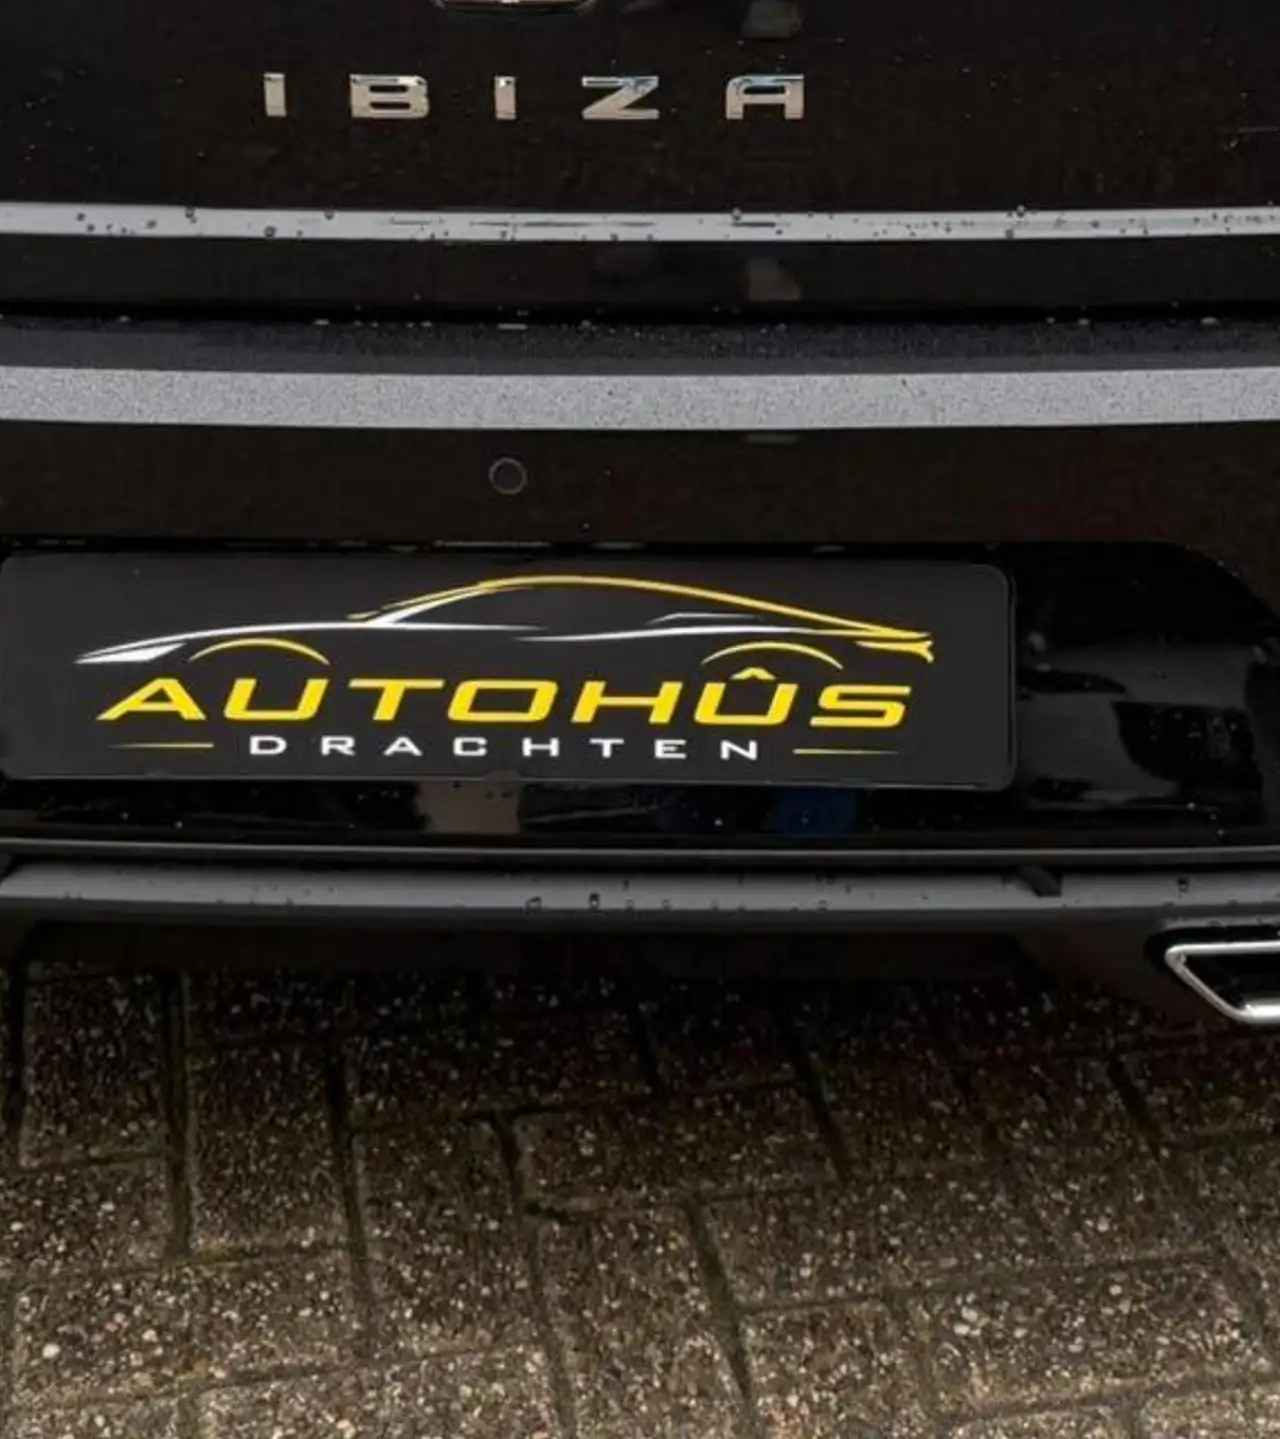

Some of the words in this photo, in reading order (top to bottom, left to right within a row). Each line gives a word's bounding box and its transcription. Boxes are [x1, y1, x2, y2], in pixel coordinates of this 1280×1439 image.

[263, 72, 805, 120] IBIZA
[96, 666, 912, 728] AUTOHÛS
[248, 734, 759, 760] DRACHTEN
